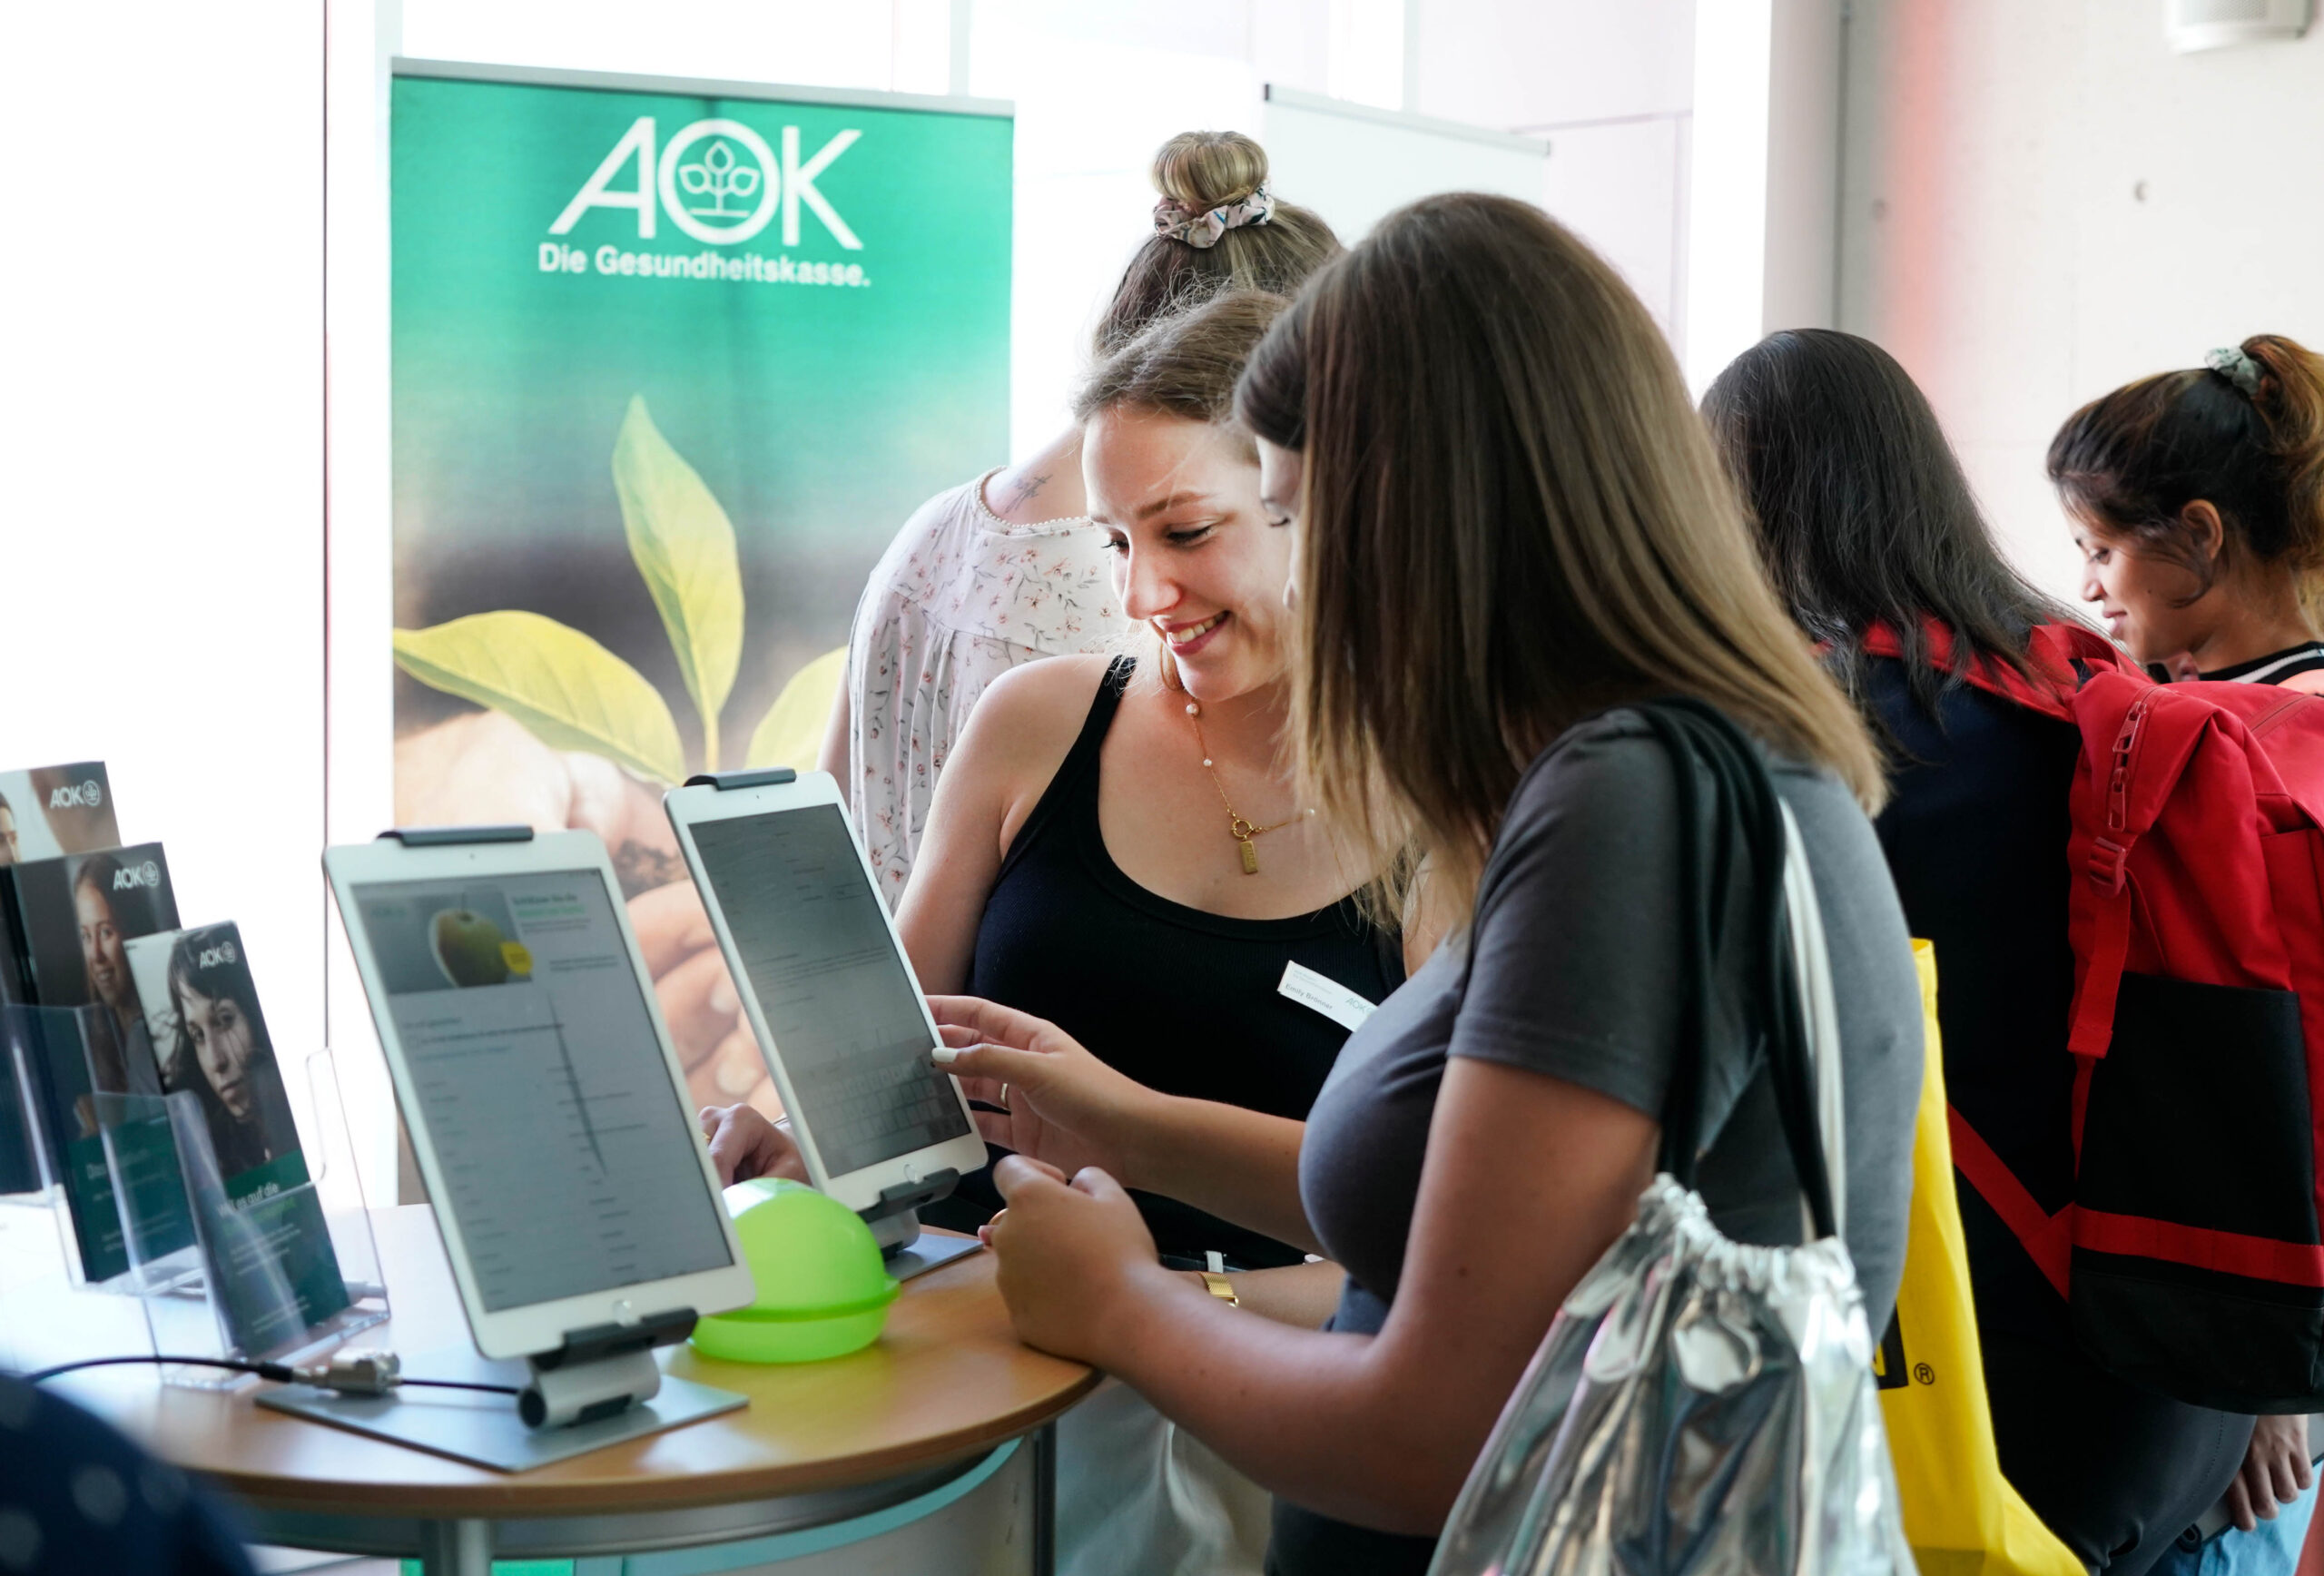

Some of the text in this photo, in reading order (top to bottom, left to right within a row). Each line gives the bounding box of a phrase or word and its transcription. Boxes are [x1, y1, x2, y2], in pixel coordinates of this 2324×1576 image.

[547, 116, 864, 251] AOK
[538, 242, 872, 287] Die Gesundheitskasse.
[50, 786, 84, 809] AOK
[113, 866, 143, 891] AOK
[199, 949, 223, 970] AOK
[1285, 983, 1305, 997] Emily
[1345, 998, 1366, 1014] AOK
[247, 1185, 263, 1205] auf
[263, 1181, 280, 1197] die
